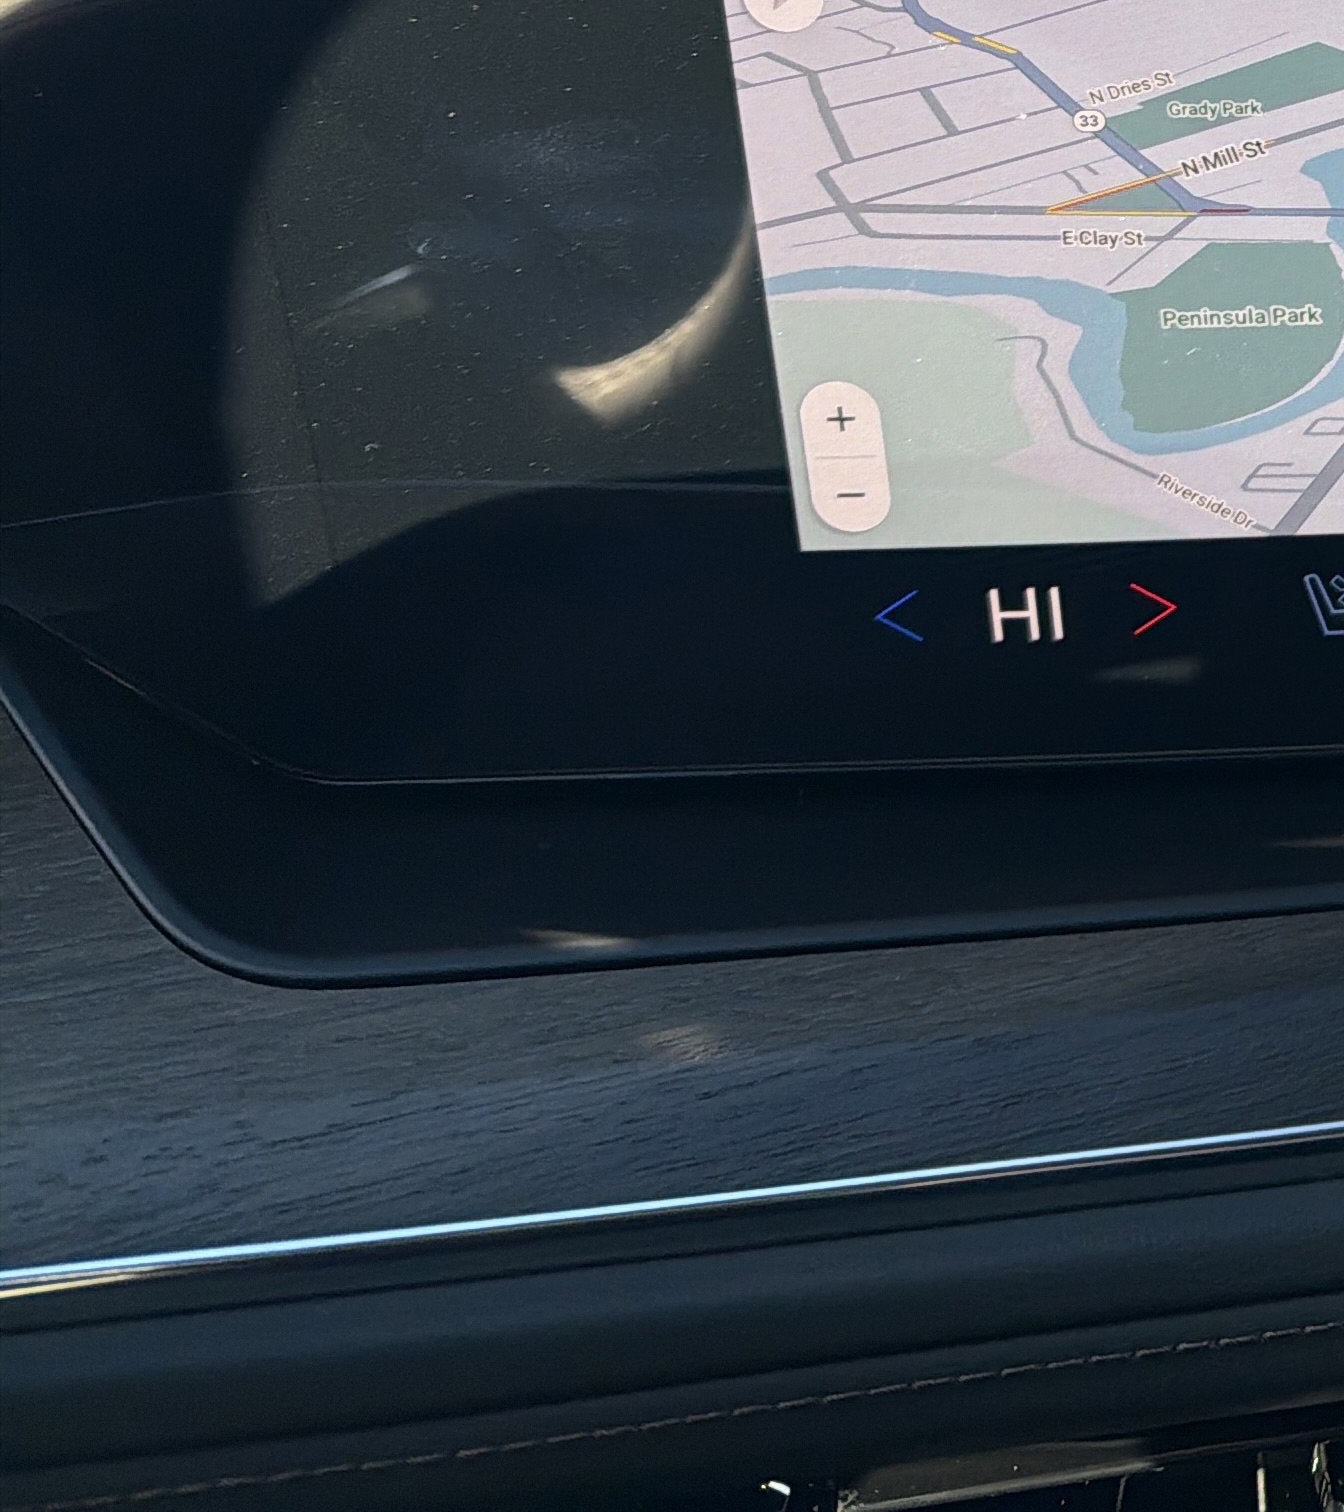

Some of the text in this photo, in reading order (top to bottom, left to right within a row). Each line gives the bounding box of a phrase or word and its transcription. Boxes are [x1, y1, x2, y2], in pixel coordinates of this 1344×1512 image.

[1090, 72, 1173, 104] N Dries St
[1079, 115, 1098, 127] 33
[1169, 101, 1260, 120] Grady Park
[1182, 141, 1266, 177] N Mill St
[1062, 231, 1144, 248] E Clay St
[1162, 306, 1322, 328] Peninsula Park
[1157, 473, 1255, 529] Riverside Dr
[987, 586, 1064, 642] HI
